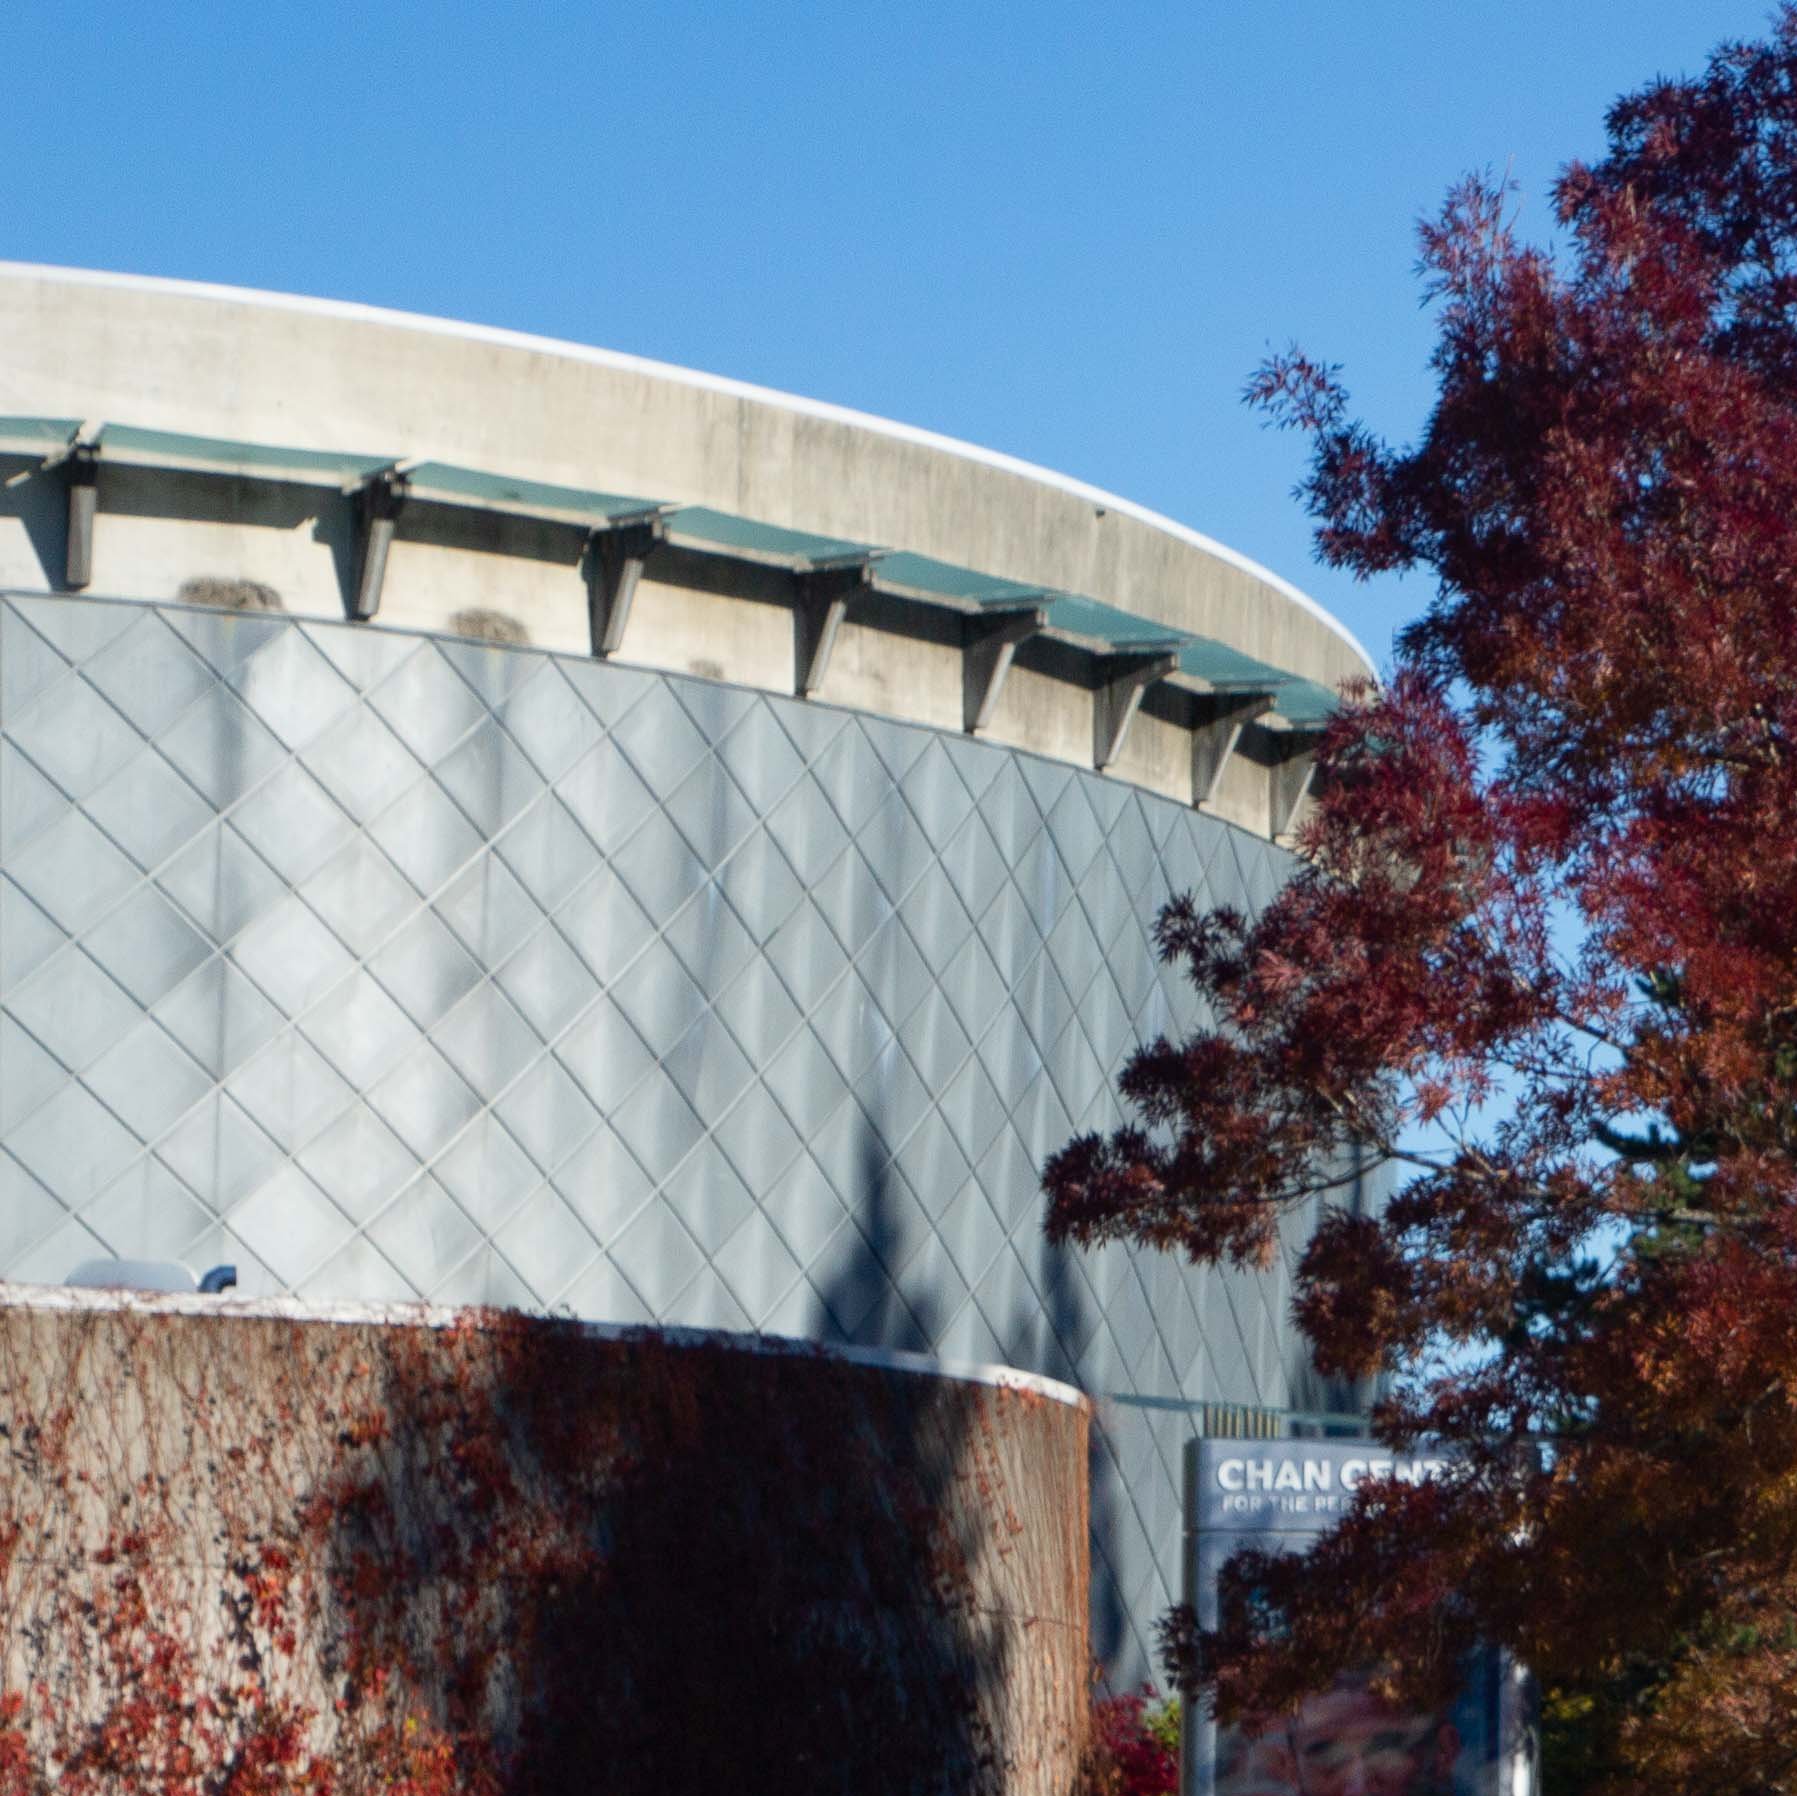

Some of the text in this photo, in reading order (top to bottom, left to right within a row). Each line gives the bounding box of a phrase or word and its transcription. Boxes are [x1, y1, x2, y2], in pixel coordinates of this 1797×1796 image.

[1217, 1458, 1491, 1492] CHAN CENT
[1222, 1495, 1263, 1513] FOR
[1270, 1495, 1308, 1513] THE
